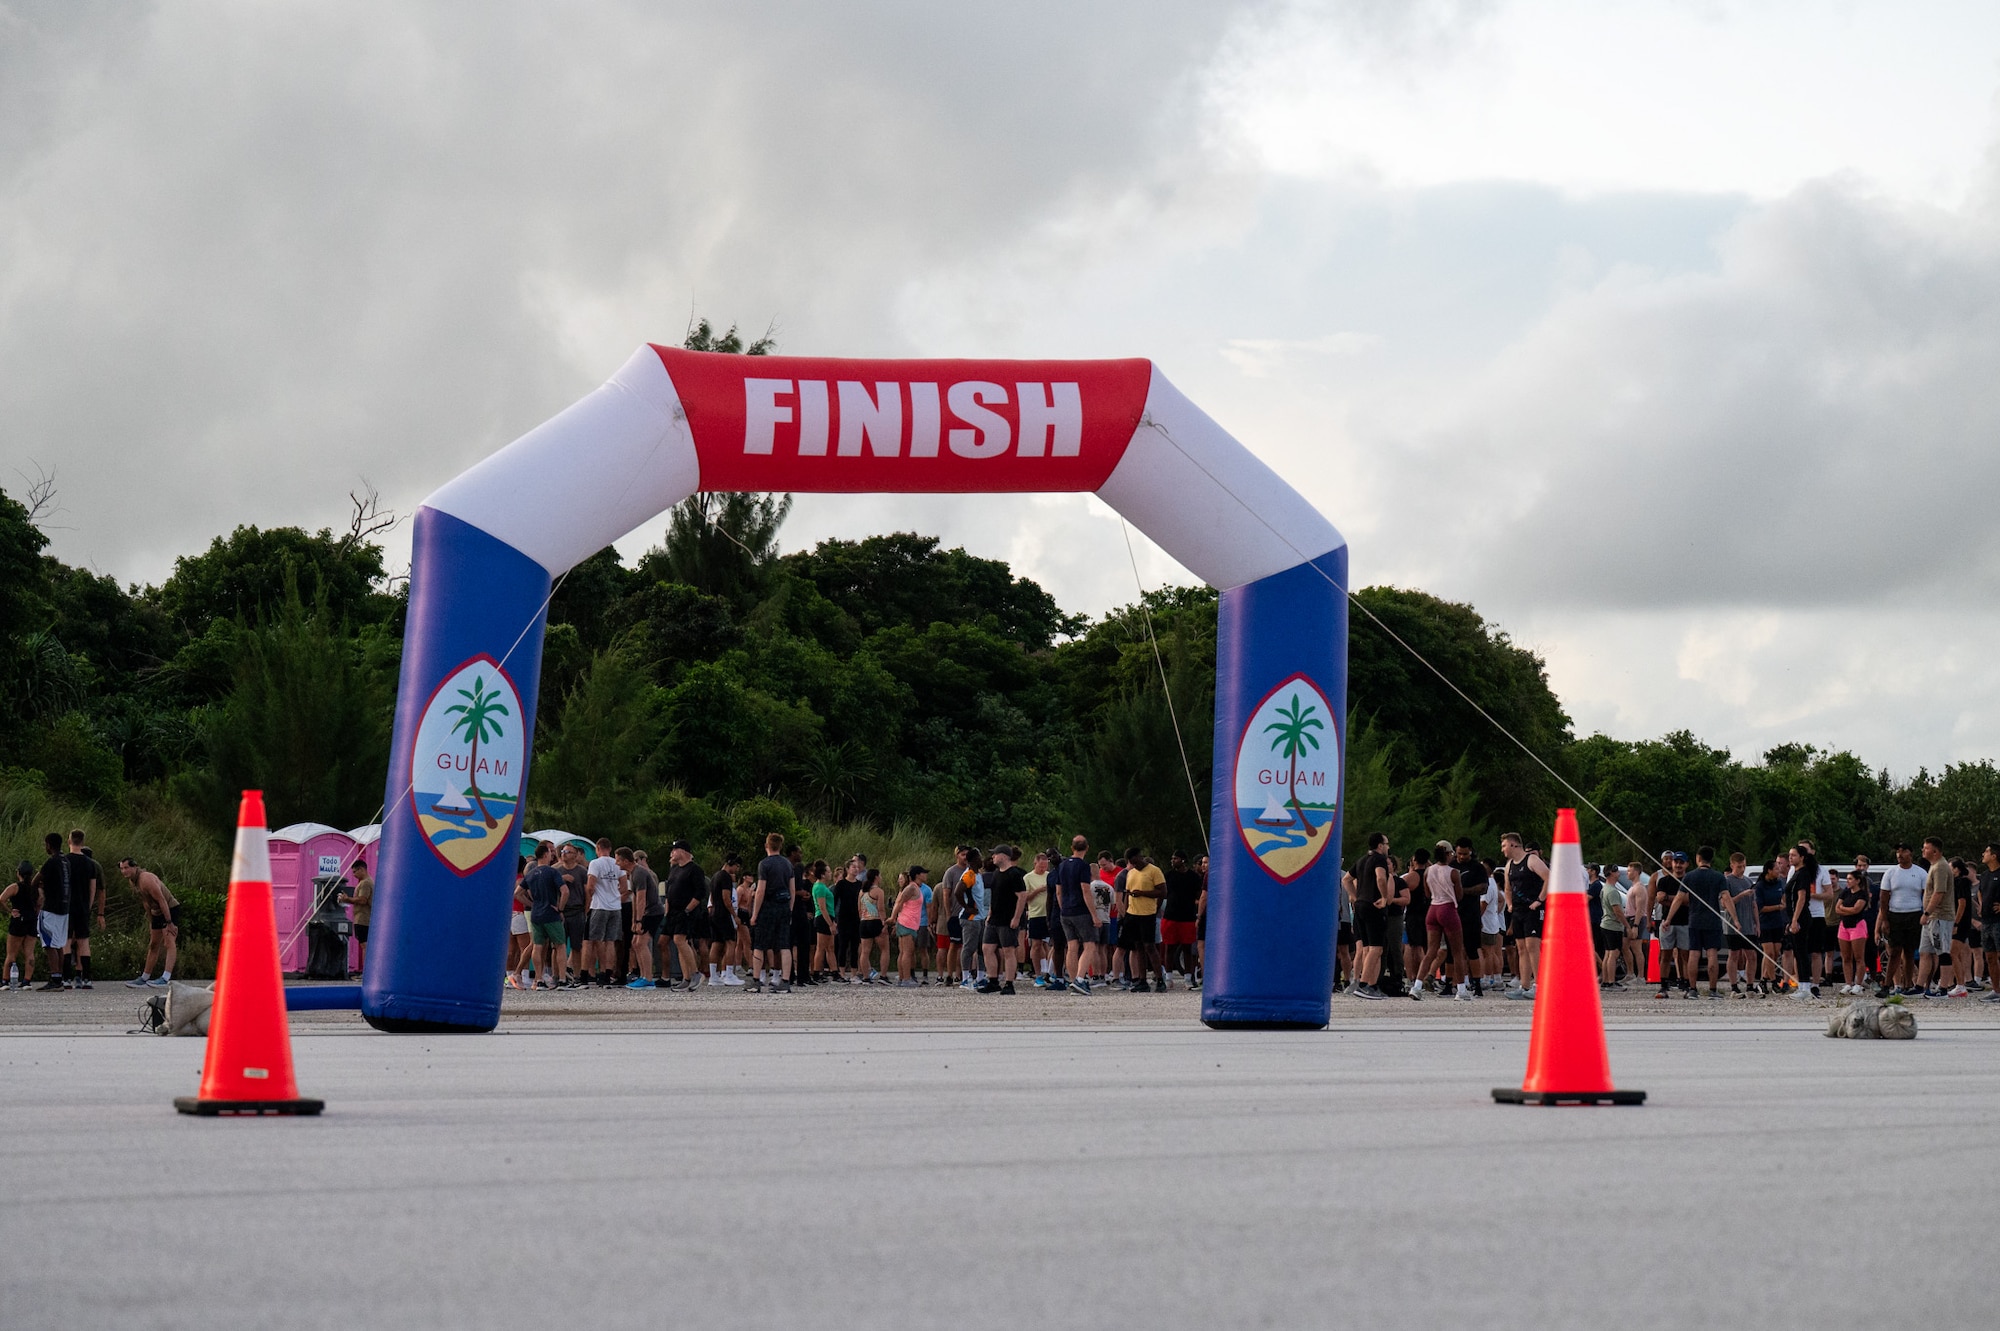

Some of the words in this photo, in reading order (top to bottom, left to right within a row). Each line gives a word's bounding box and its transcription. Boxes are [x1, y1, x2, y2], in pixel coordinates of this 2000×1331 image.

[743, 377, 1083, 459] FINISH
[437, 753, 508, 776] GUAM
[1258, 769, 1325, 787] GUAM
